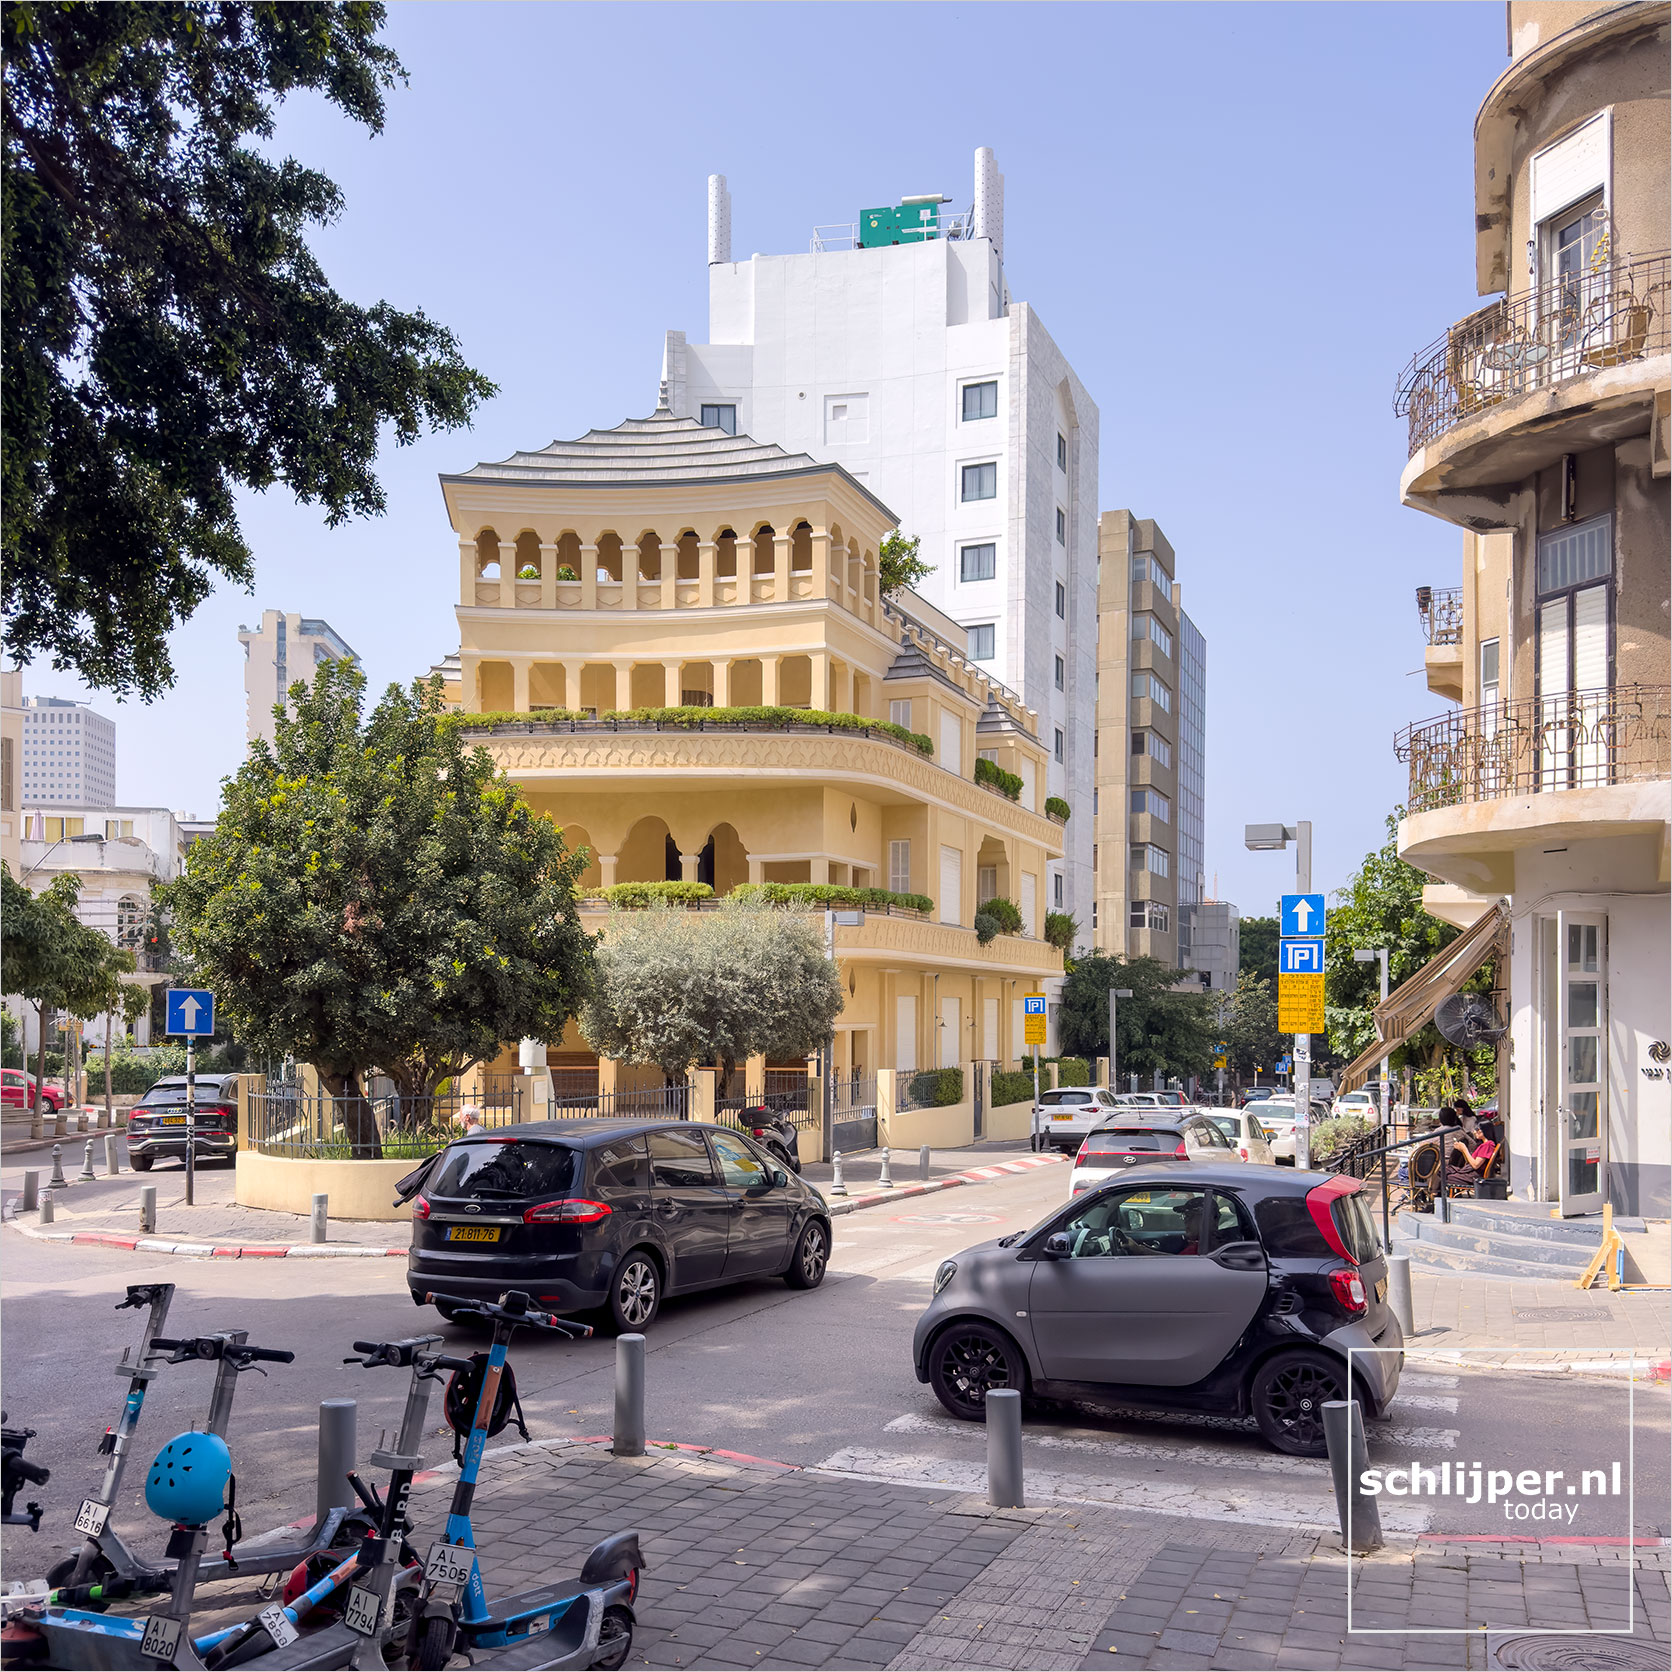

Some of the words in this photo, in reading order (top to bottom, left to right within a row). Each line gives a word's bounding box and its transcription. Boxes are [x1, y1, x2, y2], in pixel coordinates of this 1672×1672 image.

[390, 1482, 411, 1541] BIRD
[77, 1516, 102, 1534] 6616
[436, 1549, 457, 1564] AL
[428, 1563, 468, 1582] 7505
[346, 1607, 374, 1632] 7794
[144, 1637, 174, 1656] 8020
